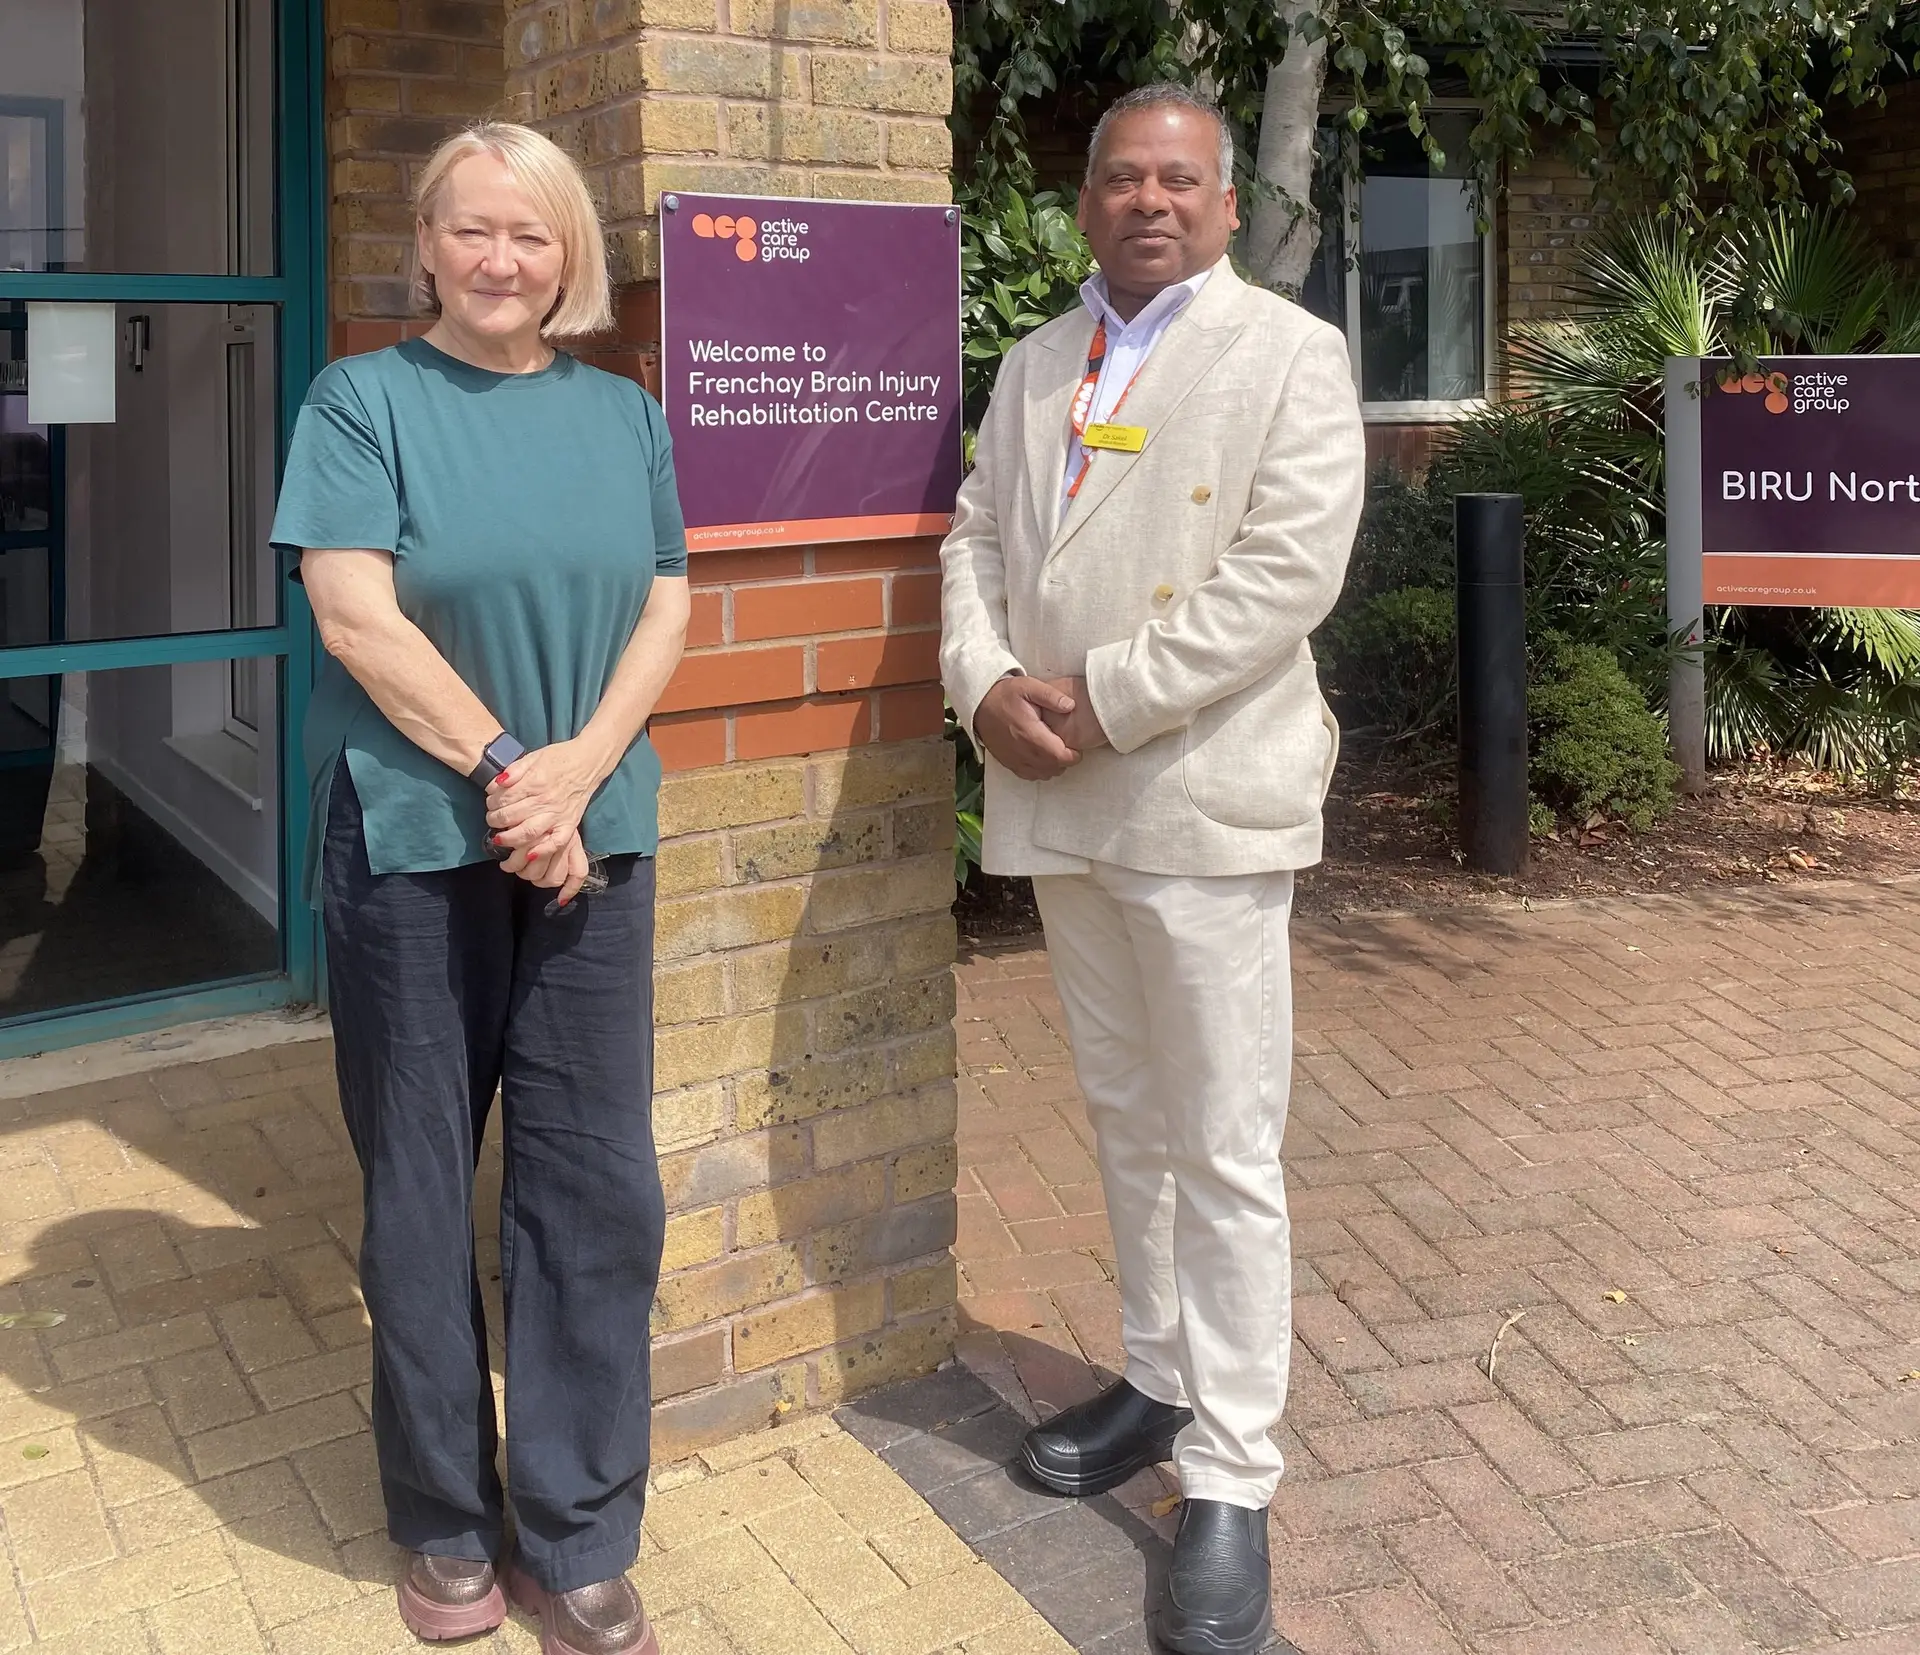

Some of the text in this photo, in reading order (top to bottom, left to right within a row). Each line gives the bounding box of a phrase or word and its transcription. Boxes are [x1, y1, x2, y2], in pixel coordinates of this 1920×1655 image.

[761, 218, 809, 234] active
[761, 233, 798, 246] care
[761, 246, 811, 263] group
[689, 339, 827, 363] Welcome to
[689, 370, 941, 398] Frenchay Brain Injury
[1793, 371, 1848, 386] active
[1793, 386, 1835, 398] care
[690, 400, 939, 427] Rehabilitation Centre
[1793, 398, 1850, 414] group
[1722, 470, 1920, 503] BIRU Nort
[693, 526, 785, 541] activecaregroup.co.uk
[1716, 585, 1817, 595] activecaregroup.co.uk
